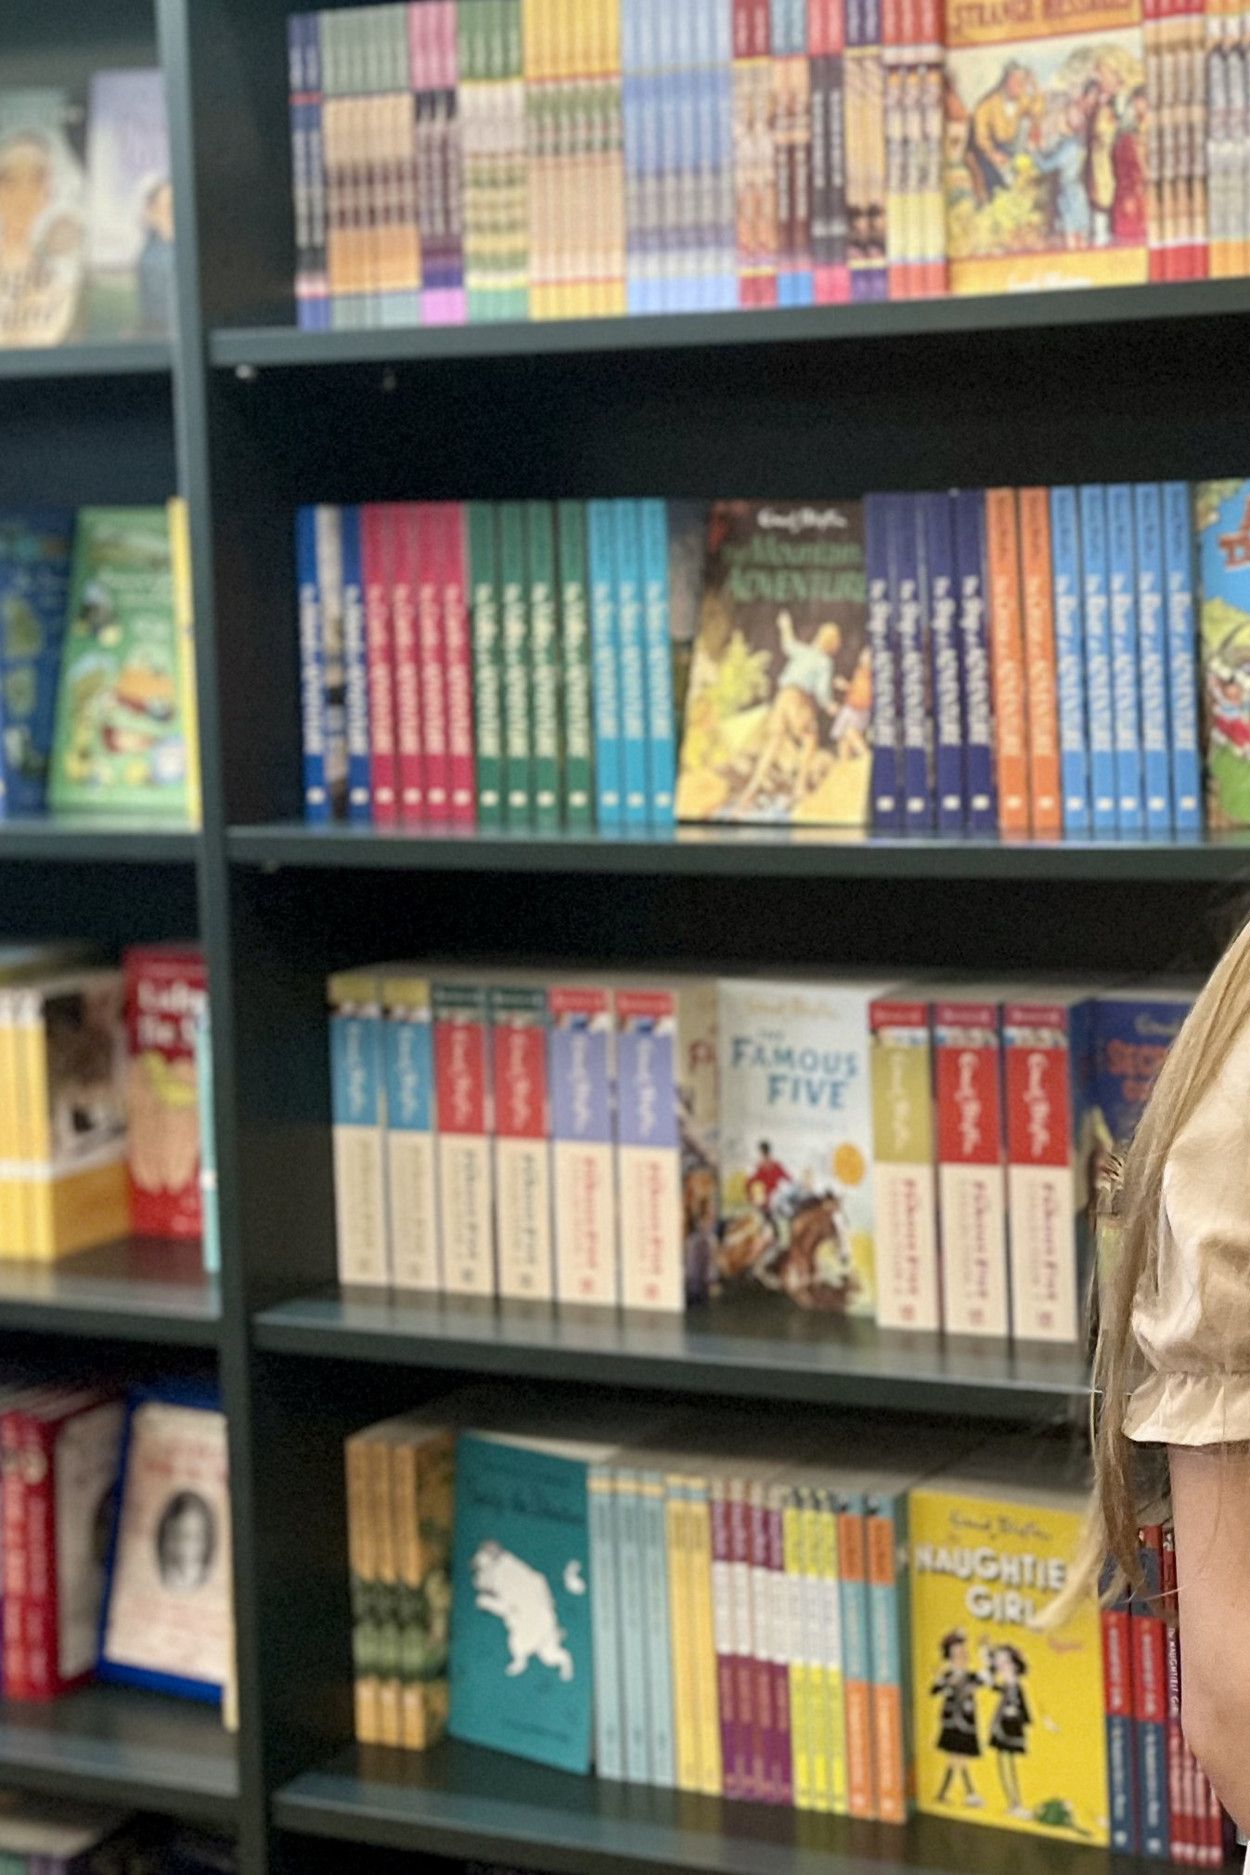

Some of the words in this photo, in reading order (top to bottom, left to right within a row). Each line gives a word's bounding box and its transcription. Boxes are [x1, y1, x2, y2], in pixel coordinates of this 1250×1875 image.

[731, 1034, 858, 1079] FAMOUS
[768, 1074, 849, 1111] FIVE
[914, 1543, 1068, 1592] NAUGHTIE
